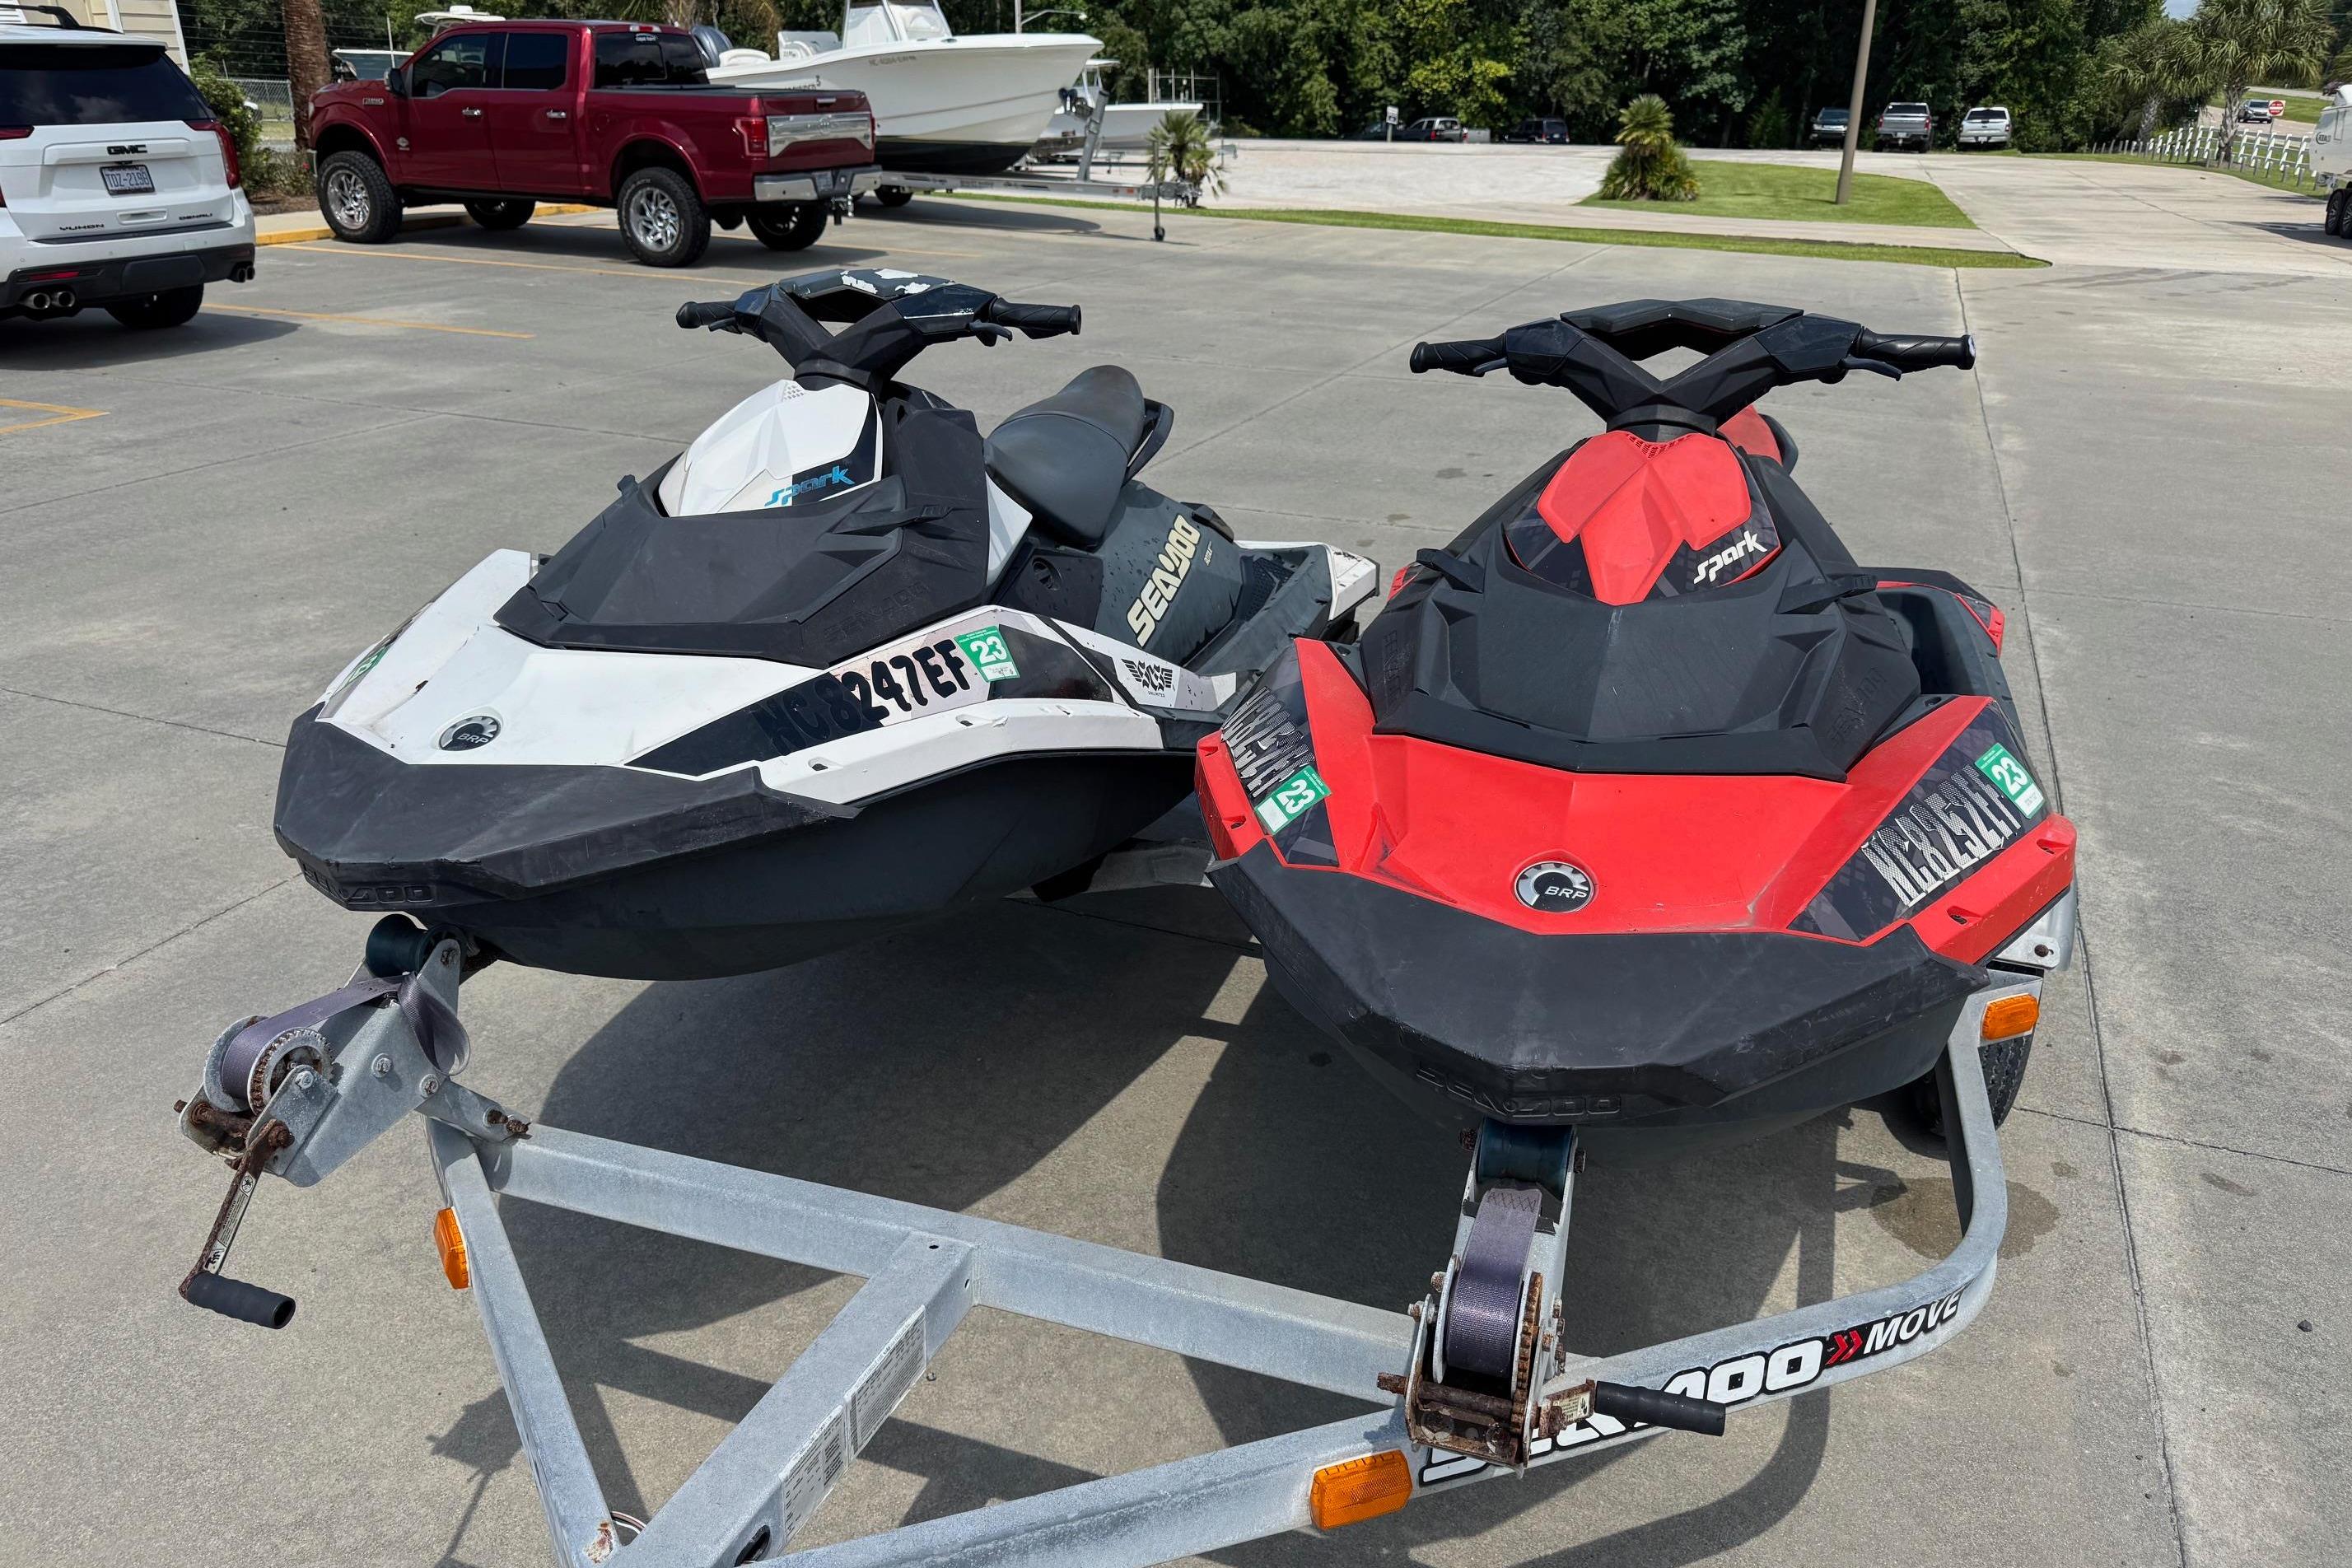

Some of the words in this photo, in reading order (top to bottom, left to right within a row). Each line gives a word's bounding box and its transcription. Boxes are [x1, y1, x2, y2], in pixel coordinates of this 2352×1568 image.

[107, 145, 147, 155] GMC
[1694, 530, 1768, 584] spark
[970, 636, 1007, 665] 23
[457, 733, 489, 744] BRP
[1991, 757, 2028, 796] 23
[1276, 779, 1316, 814] 23
[1544, 885, 1588, 899] BRP
[1863, 1287, 1965, 1356] MOVE
